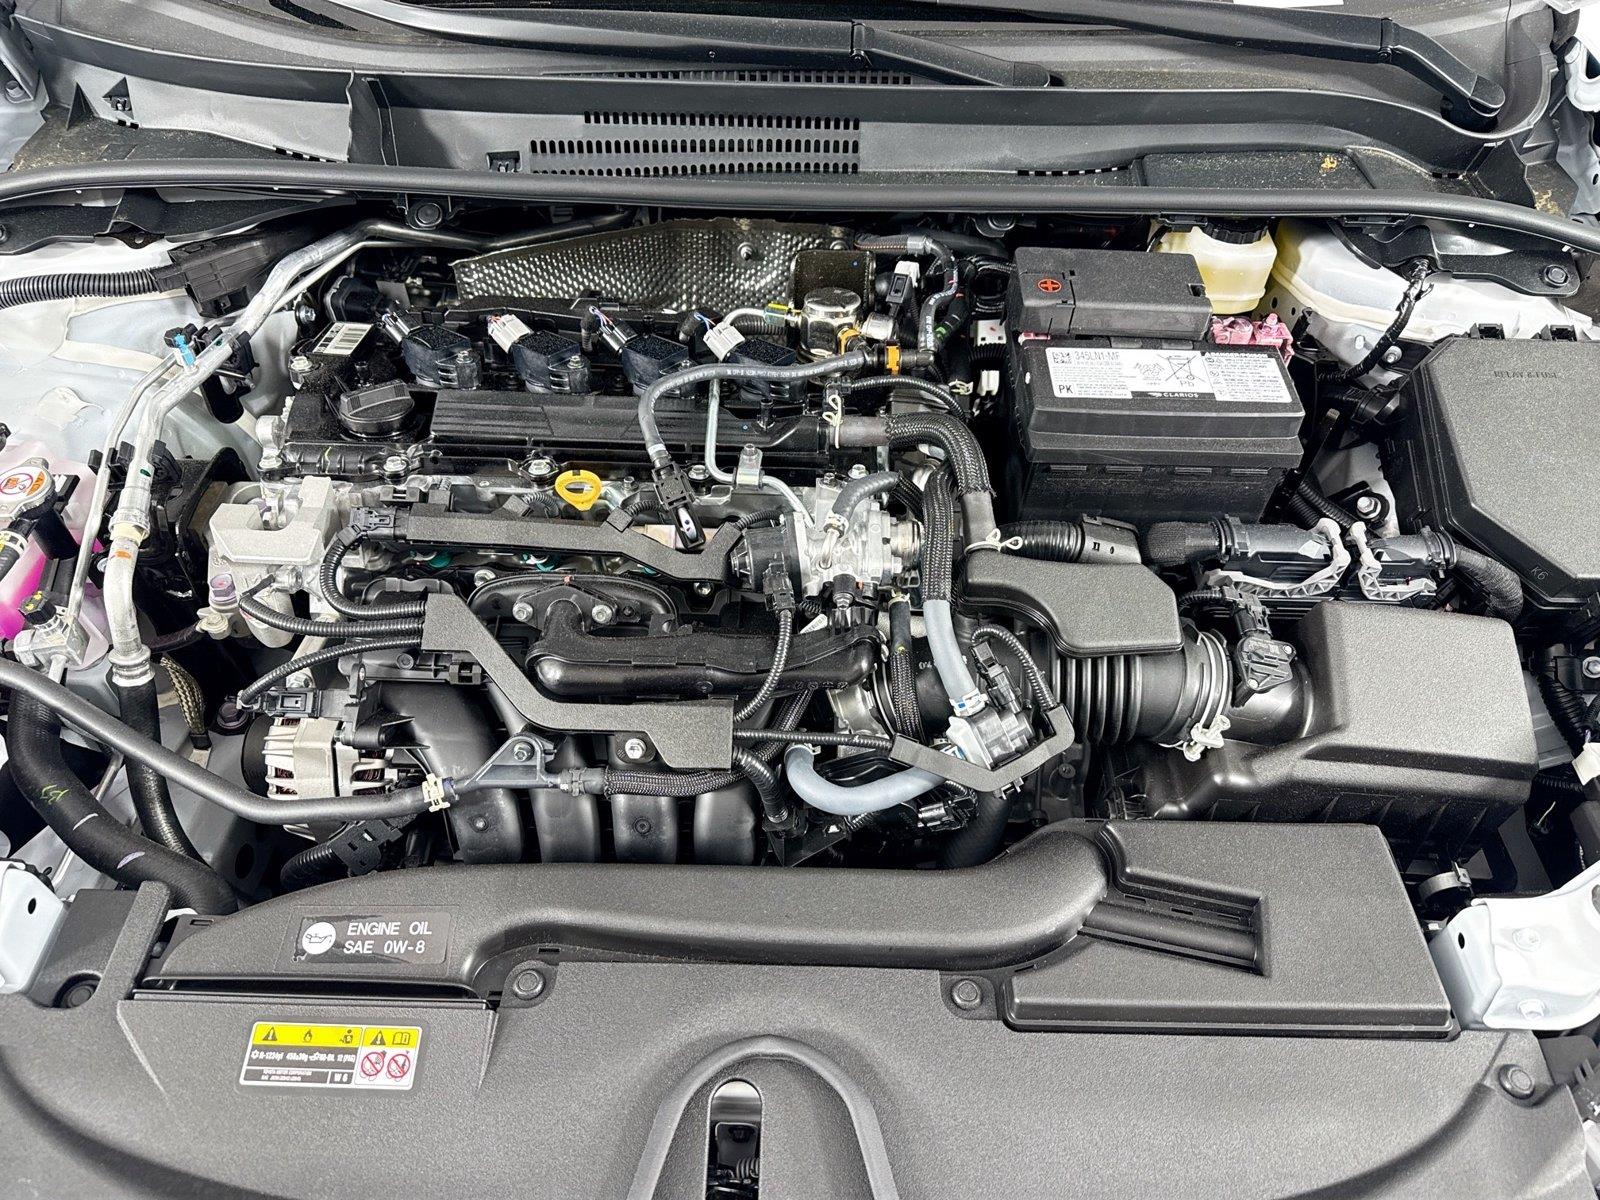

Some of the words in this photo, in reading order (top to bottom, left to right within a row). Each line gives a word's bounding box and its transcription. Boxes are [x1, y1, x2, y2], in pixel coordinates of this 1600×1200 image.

[1058, 384, 1073, 394] PK
[1530, 566, 1549, 580] K6
[347, 922, 401, 936] ENGINE
[409, 921, 433, 935] OIL
[343, 940, 374, 954] SAE
[384, 940, 426, 954] 0W-8
